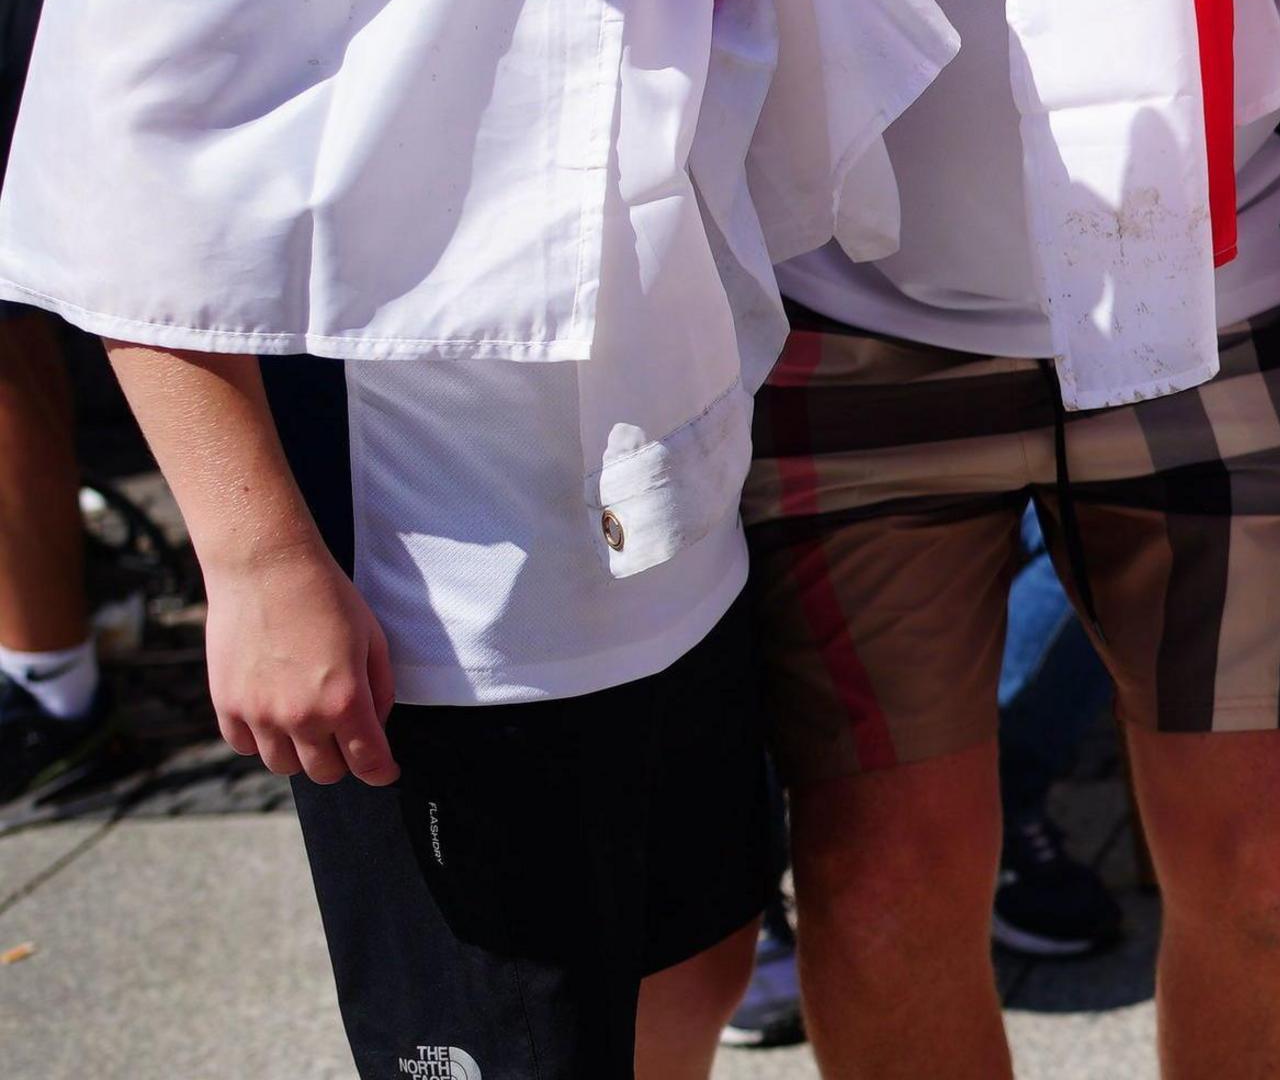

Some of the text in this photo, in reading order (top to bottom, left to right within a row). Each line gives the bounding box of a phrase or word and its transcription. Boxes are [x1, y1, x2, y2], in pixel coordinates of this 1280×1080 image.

[427, 801, 444, 866] FLASHDRY
[416, 1045, 448, 1061] THE
[398, 1057, 450, 1077] NORTH
